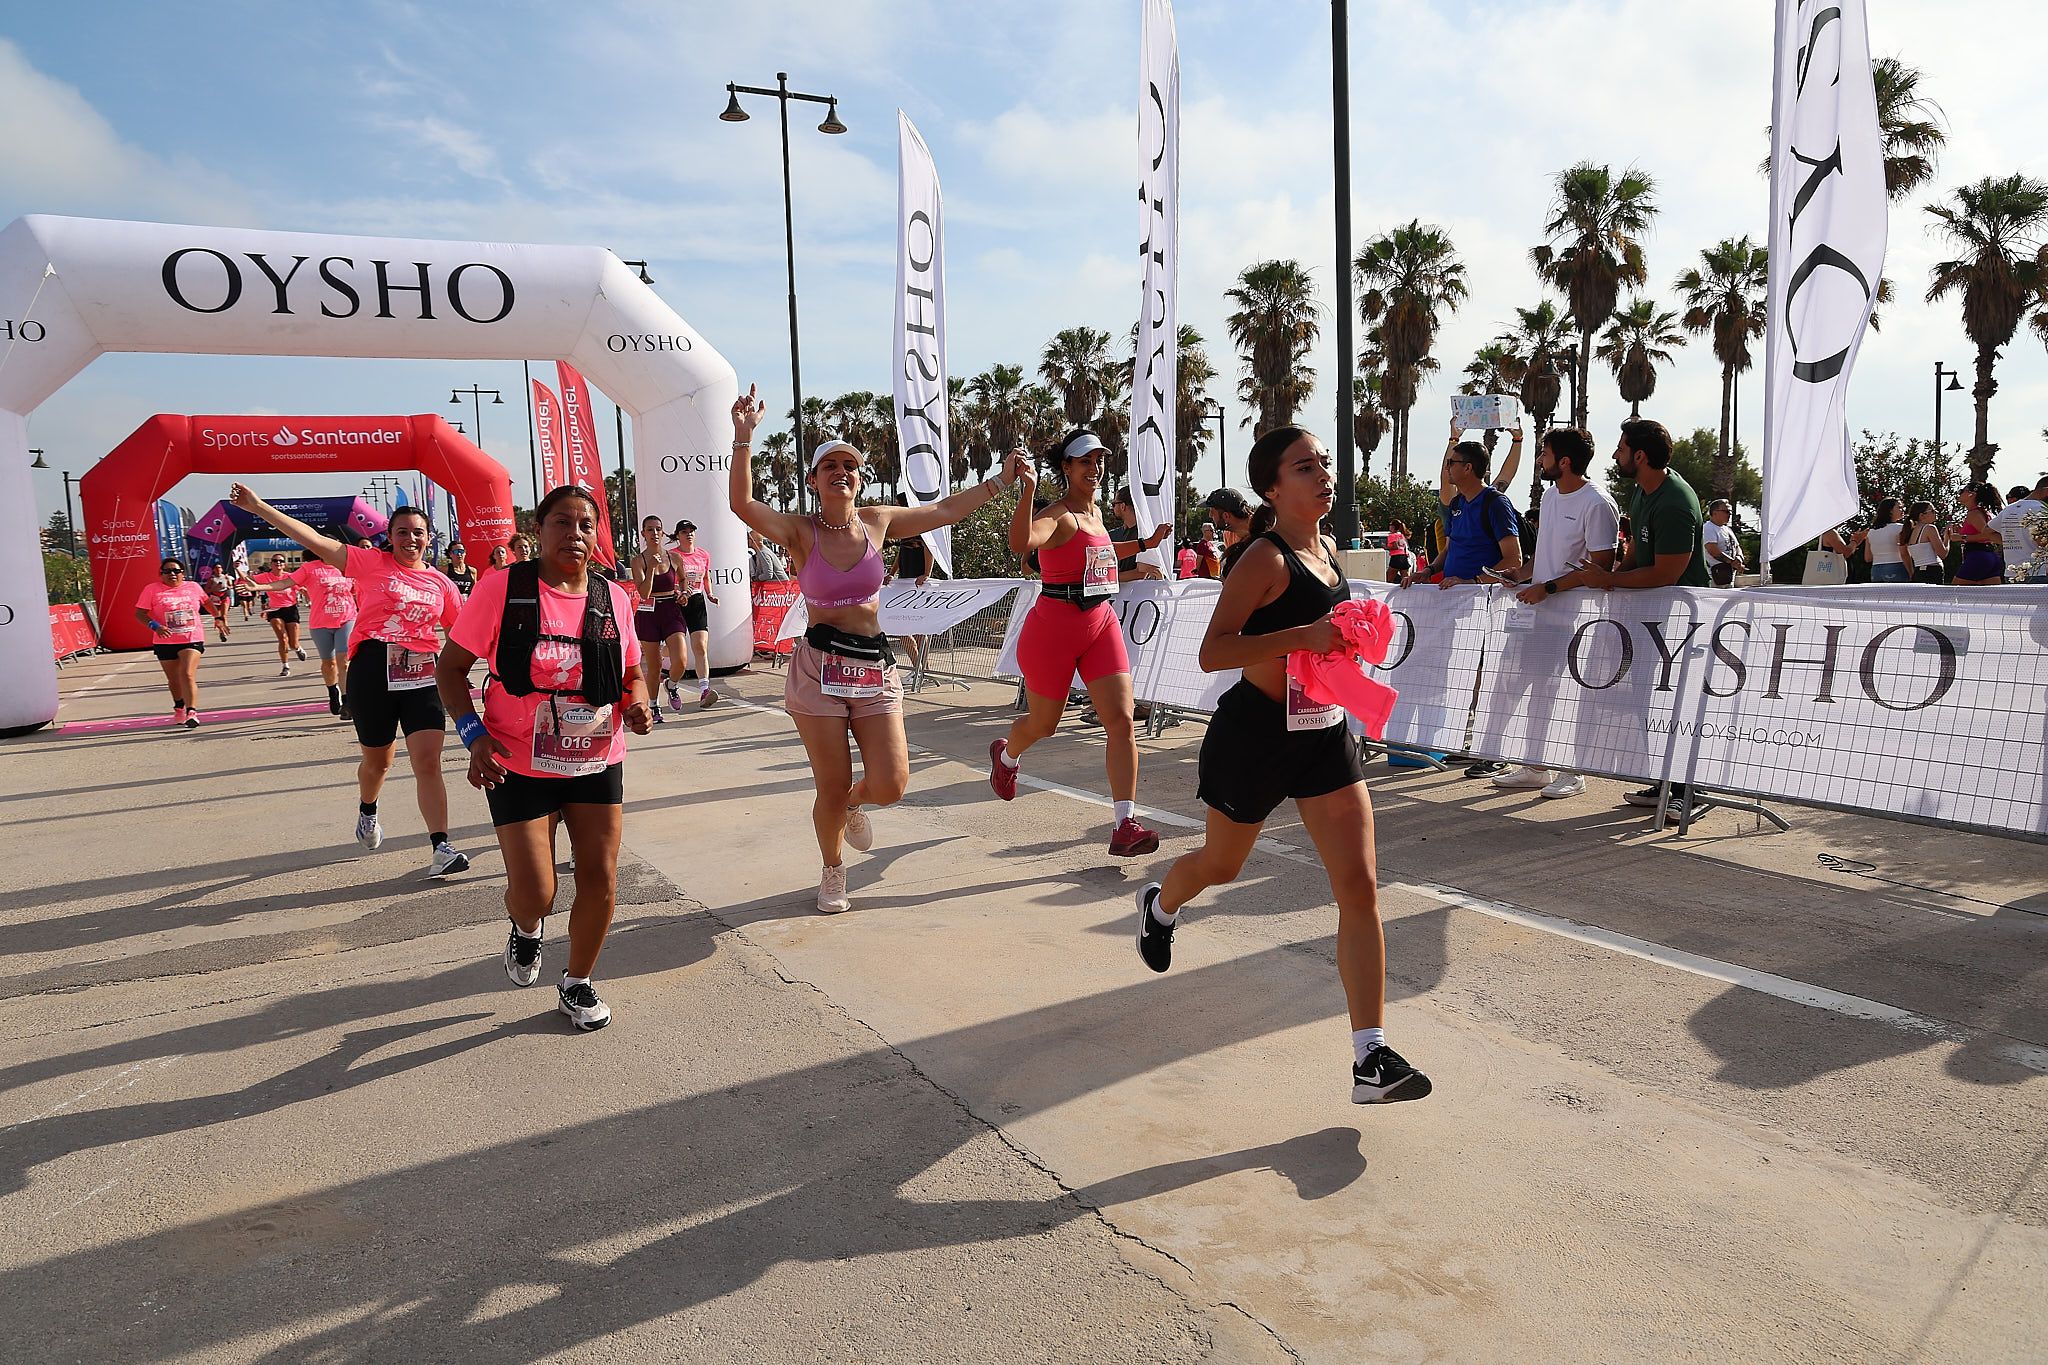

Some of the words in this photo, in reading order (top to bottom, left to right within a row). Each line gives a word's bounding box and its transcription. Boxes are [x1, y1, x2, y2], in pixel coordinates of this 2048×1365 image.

[162, 247, 515, 323] OYSHO
[606, 334, 692, 352] OYSHO
[202, 429, 269, 451] Sports
[301, 428, 402, 446] Santander
[271, 452, 338, 460] sportssantander.es
[298, 503, 323, 511] energy
[476, 505, 503, 514] Sports
[102, 519, 136, 530] Sports
[475, 517, 512, 526] Santander
[101, 532, 150, 543] Santander
[709, 567, 743, 587] HO
[760, 588, 798, 608] Santander
[833, 598, 852, 607] NIKE
[1567, 619, 1957, 712] OYSHO
[842, 666, 866, 677] 016
[1297, 716, 1327, 725] OYSHO
[1645, 718, 1822, 749] WWW.OYSHO.COM
[561, 736, 592, 749] 016
[540, 761, 567, 772] OYSHO
